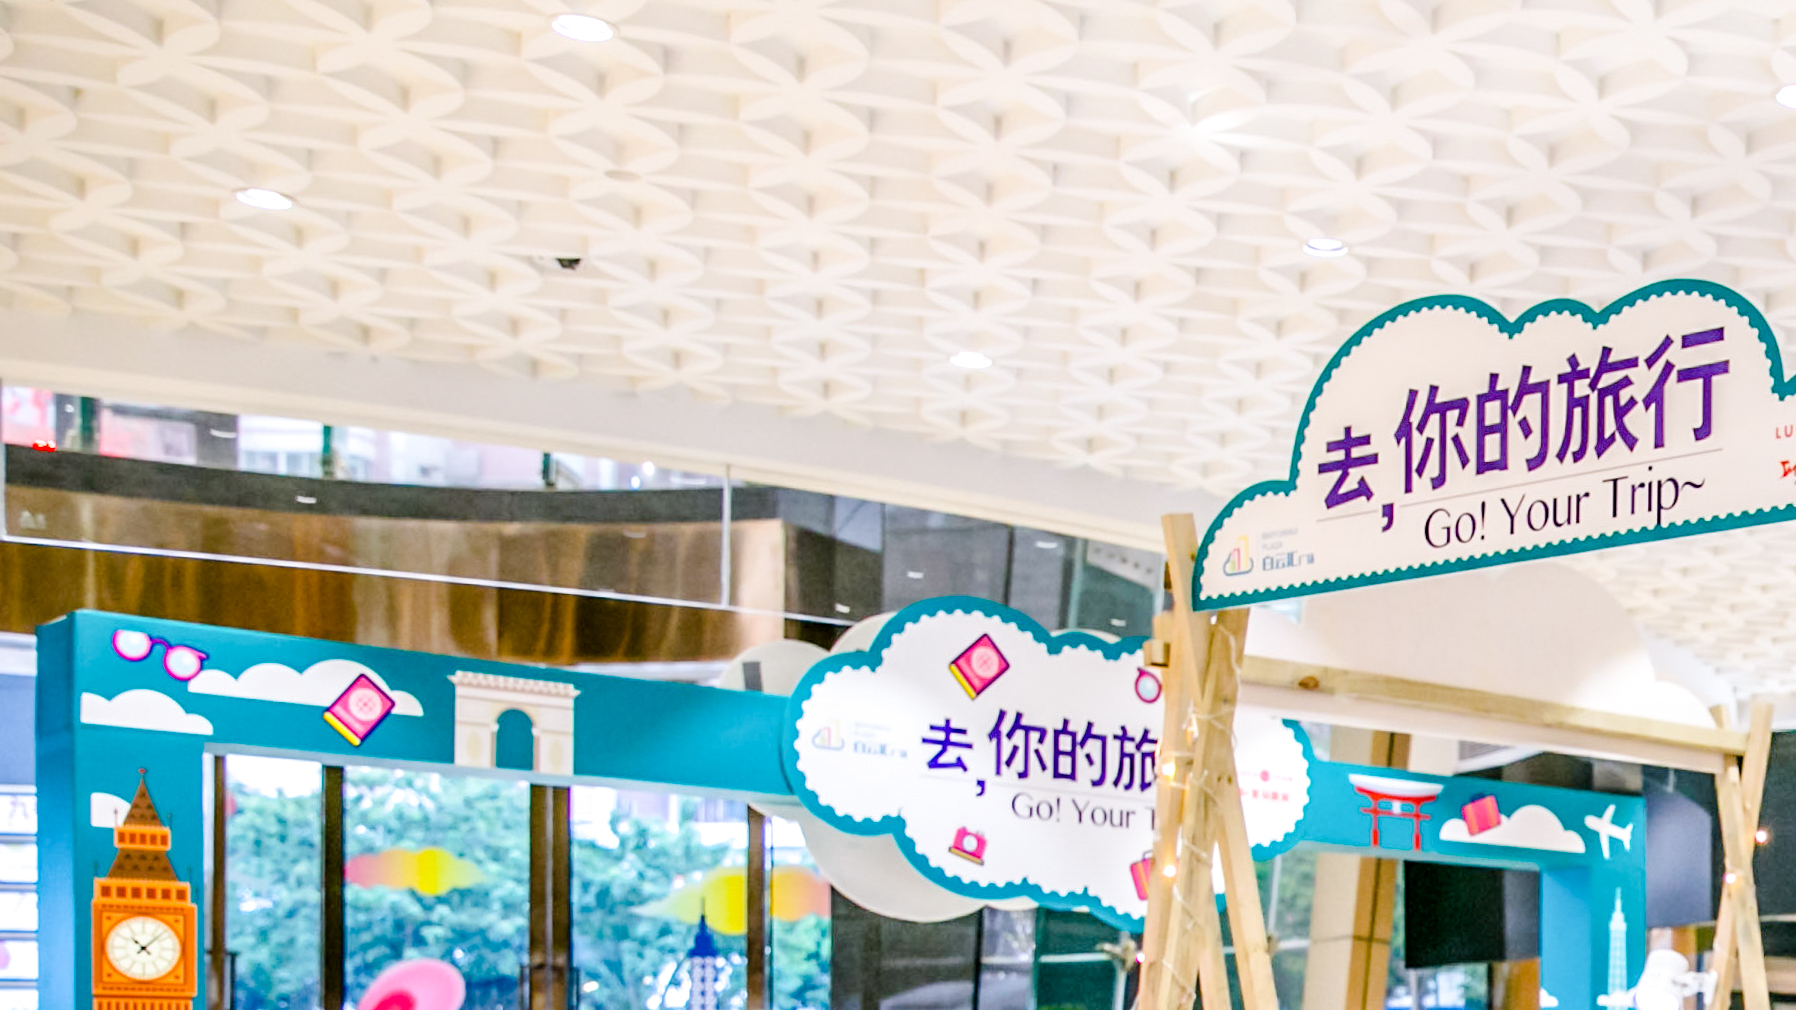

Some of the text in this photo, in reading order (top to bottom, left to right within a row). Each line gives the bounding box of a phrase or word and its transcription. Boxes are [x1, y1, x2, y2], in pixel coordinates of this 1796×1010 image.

[1424, 501, 1487, 548] Go!
[1501, 491, 1590, 535] Your
[1011, 792, 1061, 824] Go!
[1072, 798, 1136, 830] Your
